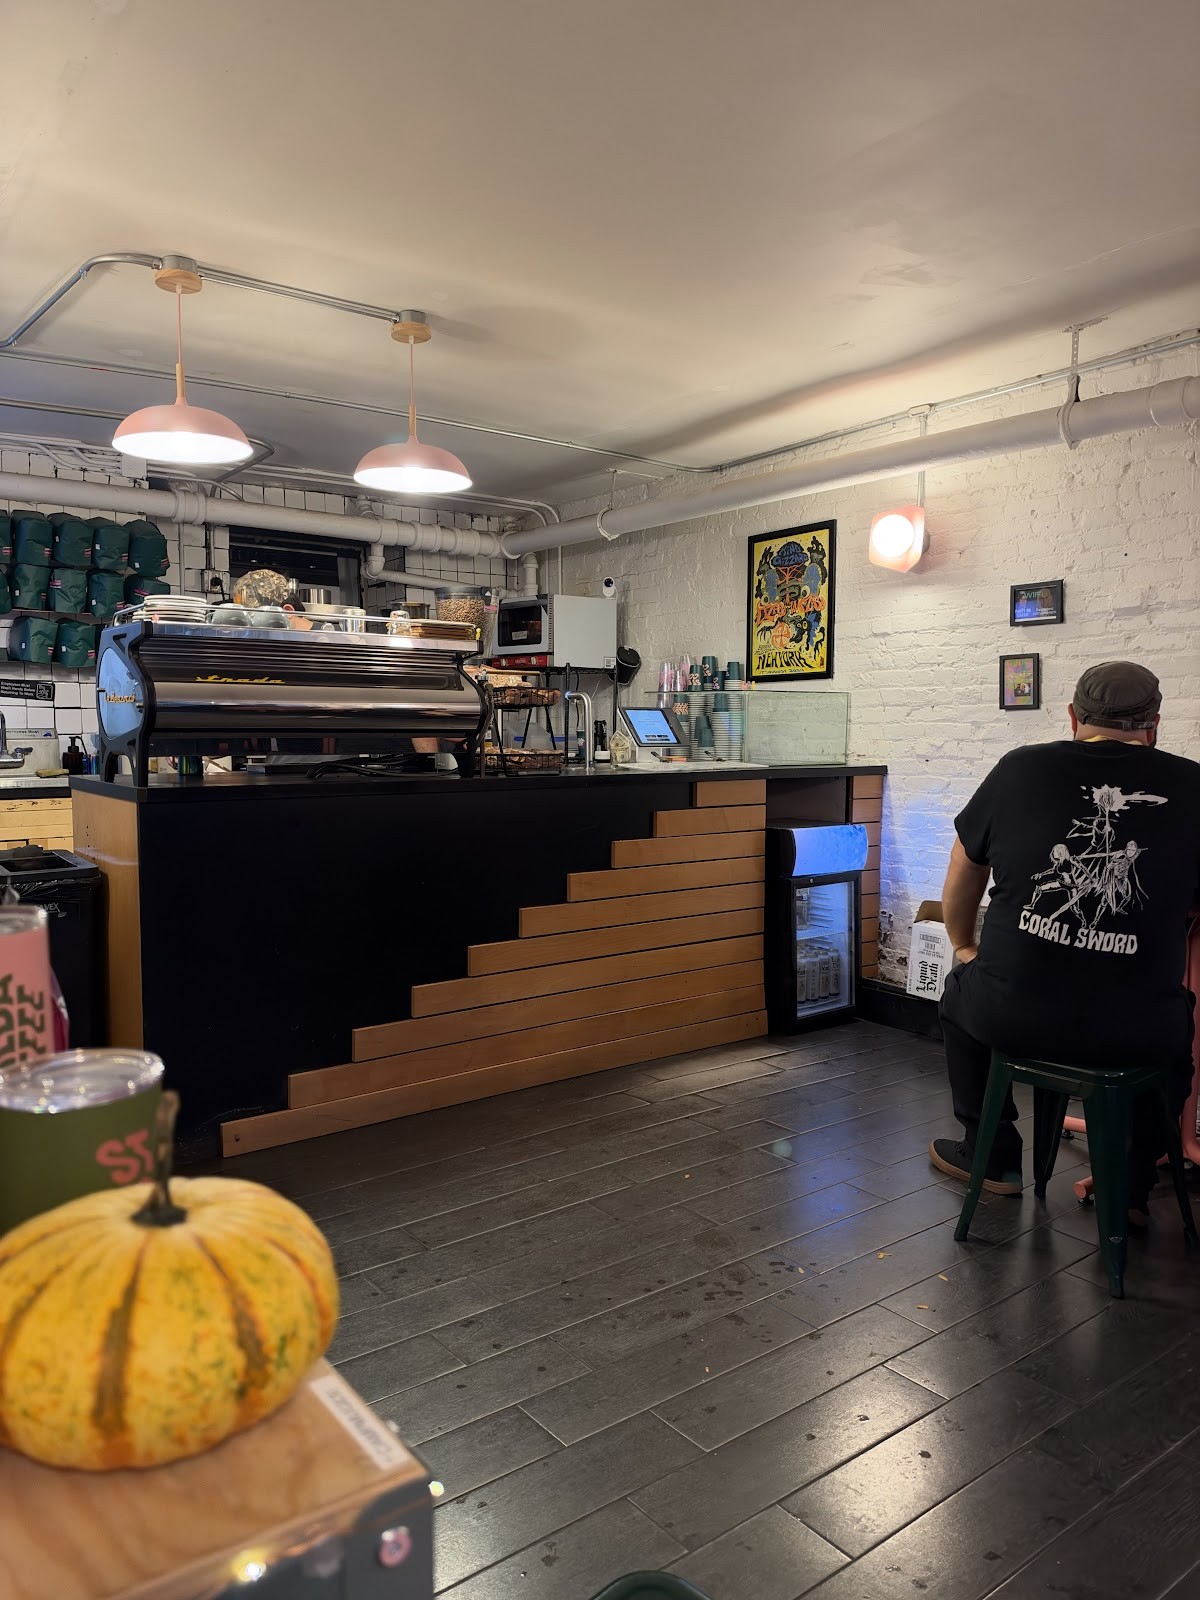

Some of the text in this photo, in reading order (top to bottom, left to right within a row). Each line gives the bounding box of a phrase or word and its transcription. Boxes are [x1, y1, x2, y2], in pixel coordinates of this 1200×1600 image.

[773, 553, 808, 565] GIZZARD
[779, 544, 802, 557] KING
[756, 652, 777, 671] NEW
[776, 650, 815, 669] YORK
[38, 902, 61, 912] AVEX
[1018, 910, 1138, 955] CORAL SWORD
[915, 960, 928, 993] Liquid
[927, 963, 939, 993] Death
[17, 984, 47, 1062] FEE
